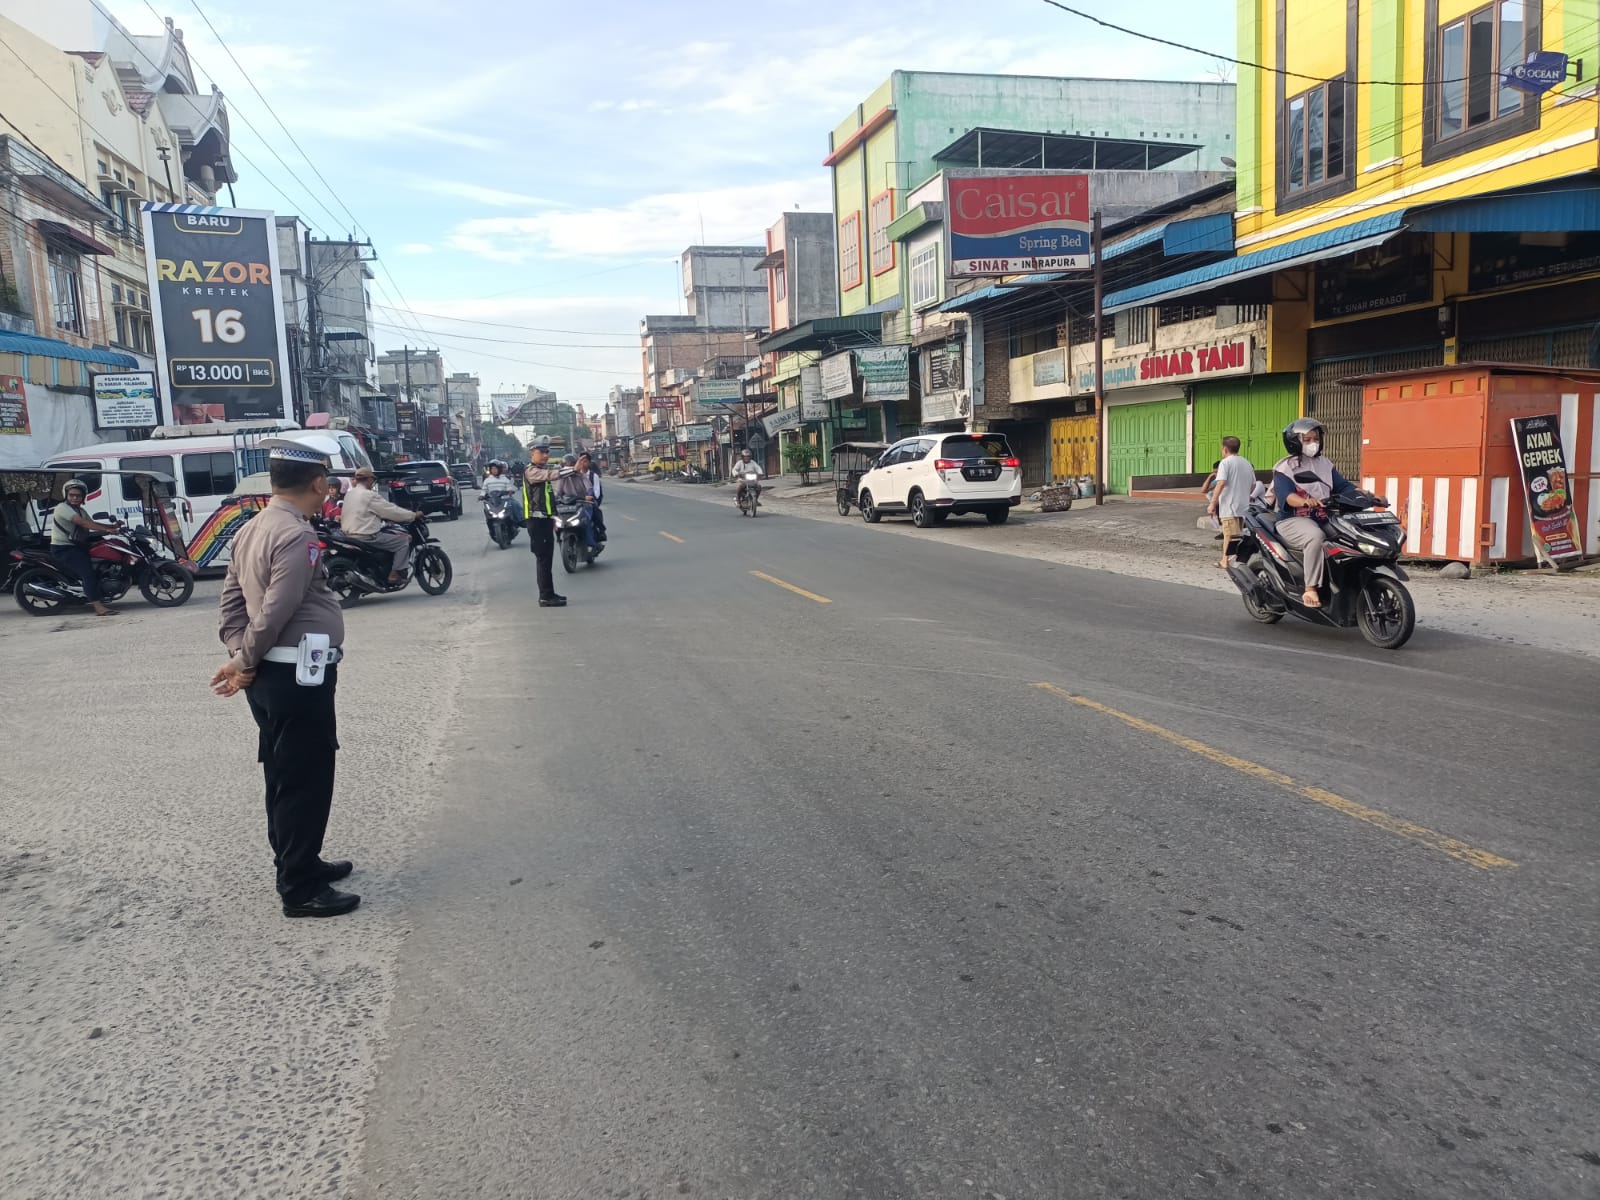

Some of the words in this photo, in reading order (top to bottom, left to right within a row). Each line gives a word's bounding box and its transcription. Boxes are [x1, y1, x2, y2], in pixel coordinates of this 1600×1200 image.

[1527, 69, 1560, 79] OCEAN
[956, 184, 1076, 221] Caisar
[187, 215, 230, 227] BARU
[1019, 235, 1057, 251] Spring
[1061, 234, 1082, 247] Bed
[156, 258, 272, 285] RAZOR
[969, 259, 1009, 271] SINAR
[1512, 266, 1545, 281] SINAR
[182, 287, 249, 297] KRETEK
[1345, 301, 1368, 313] SINAR
[1369, 293, 1408, 308] PERABOT
[191, 308, 246, 344] 16
[188, 365, 243, 380] 13.000
[1079, 369, 1096, 388] tok
[1140, 351, 1196, 380] SINAR
[1197, 342, 1245, 372] TANI
[1526, 431, 1552, 449] AYAM
[1523, 448, 1562, 468] GEPREK
